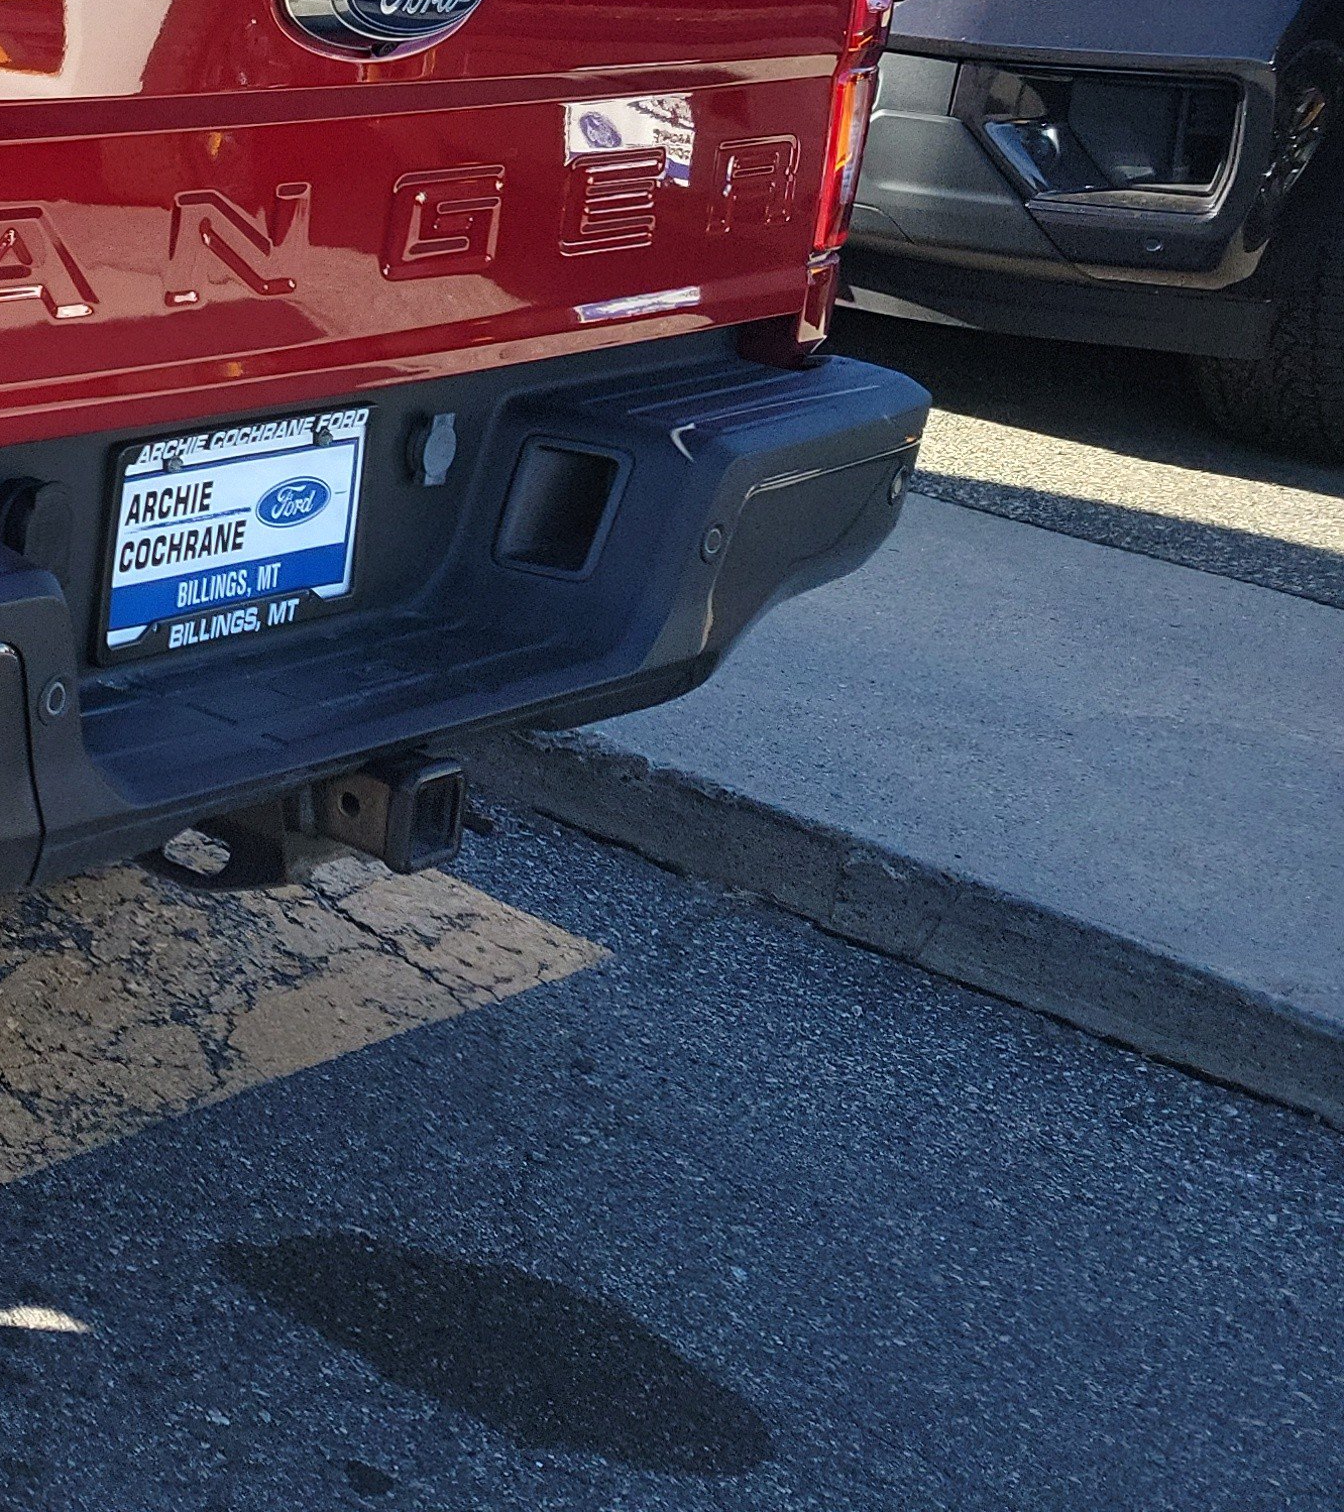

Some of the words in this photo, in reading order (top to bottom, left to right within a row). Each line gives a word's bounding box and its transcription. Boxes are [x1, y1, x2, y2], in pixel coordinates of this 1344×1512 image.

[135, 434, 207, 466] ARCHIE
[209, 416, 315, 452] COCHRANE
[315, 408, 369, 434] FORD
[124, 480, 214, 526] ARCHIE
[118, 519, 247, 573] COCHRANE
[176, 569, 252, 609] BILLINGS,
[256, 563, 281, 592] MT
[168, 605, 261, 649] BILLINGS,
[267, 598, 300, 627] MT
